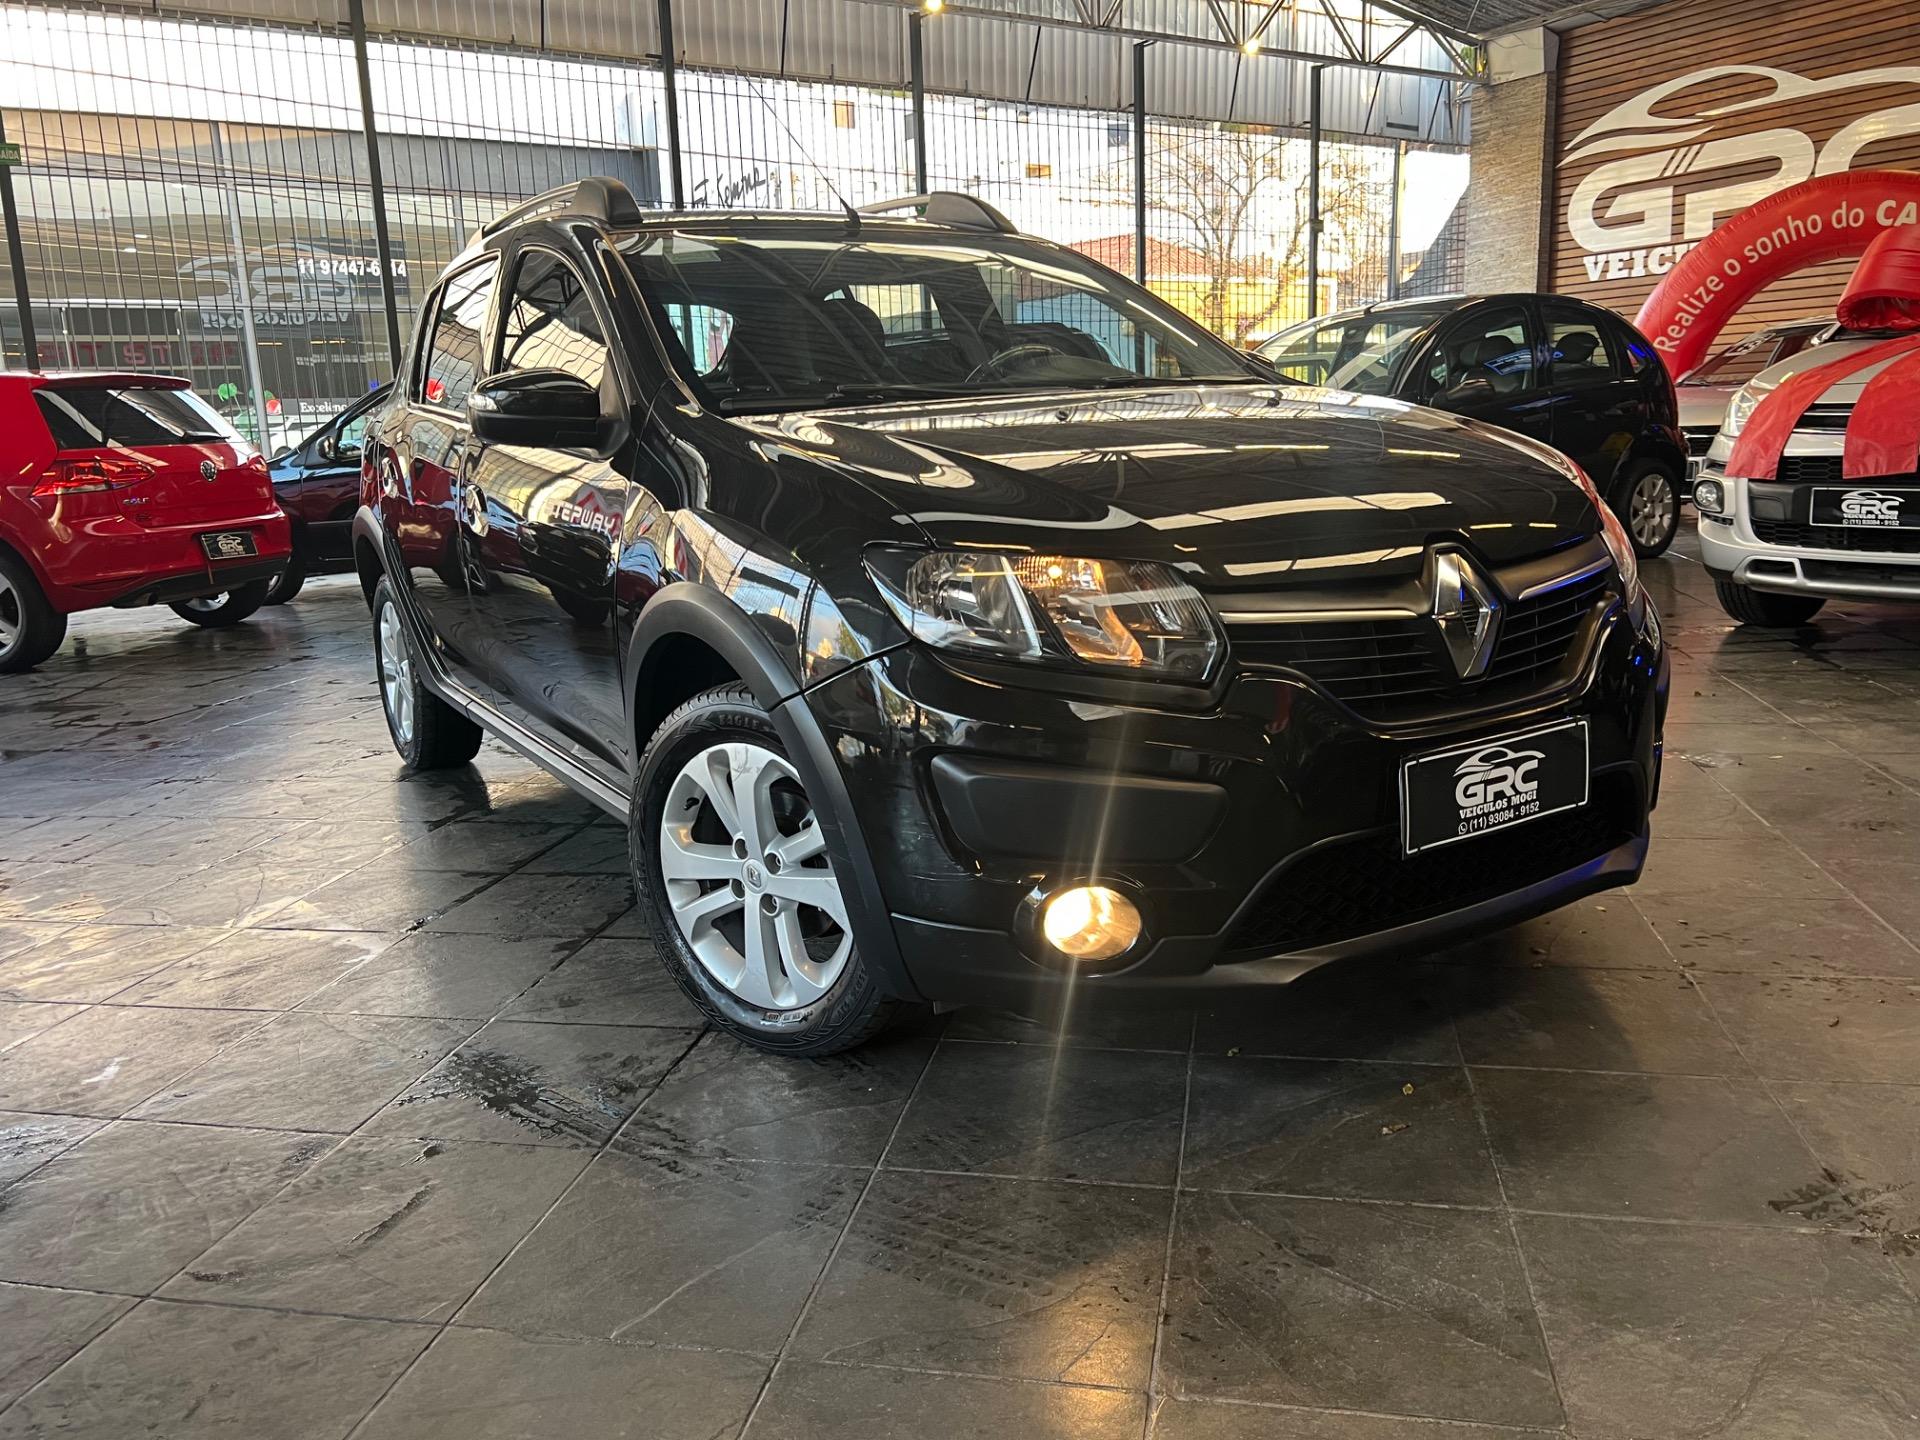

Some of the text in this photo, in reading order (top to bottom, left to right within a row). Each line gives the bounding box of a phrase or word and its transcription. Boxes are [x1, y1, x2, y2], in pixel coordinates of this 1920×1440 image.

[298, 258, 406, 277] 11 97447-614
[1653, 199, 1917, 352] Realize o sonho do CA
[545, 500, 615, 535] TEPWAY
[1841, 500, 1899, 515] GRC
[1455, 759, 1538, 807] GRC
[1460, 790, 1537, 819] VEICULOS MOGI
[1470, 816, 1487, 832] (11)
[1520, 801, 1540, 816] 9152
